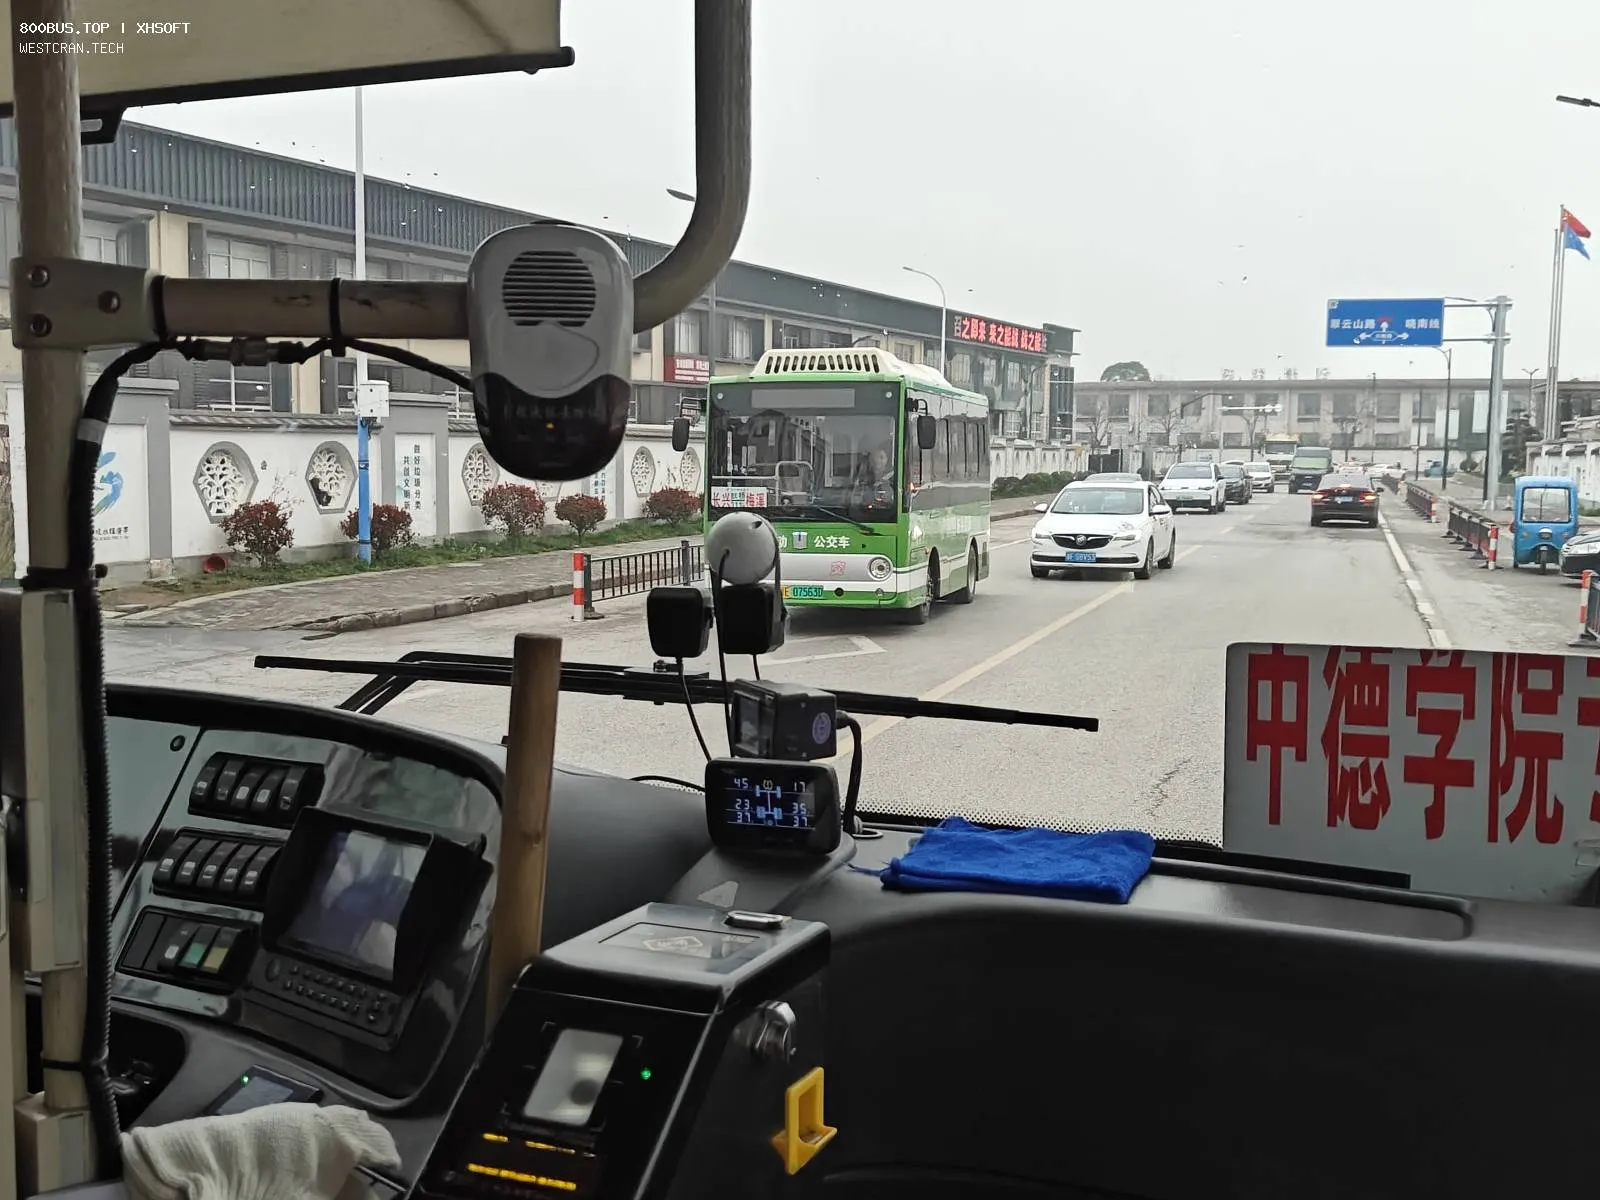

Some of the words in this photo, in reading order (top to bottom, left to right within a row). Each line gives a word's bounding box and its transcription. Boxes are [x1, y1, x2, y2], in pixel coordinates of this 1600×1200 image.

[814, 535, 850, 549] 公交车
[734, 777, 749, 789] 45
[735, 798, 750, 810] 23
[736, 811, 751, 823] 37
[793, 815, 808, 827] 37
